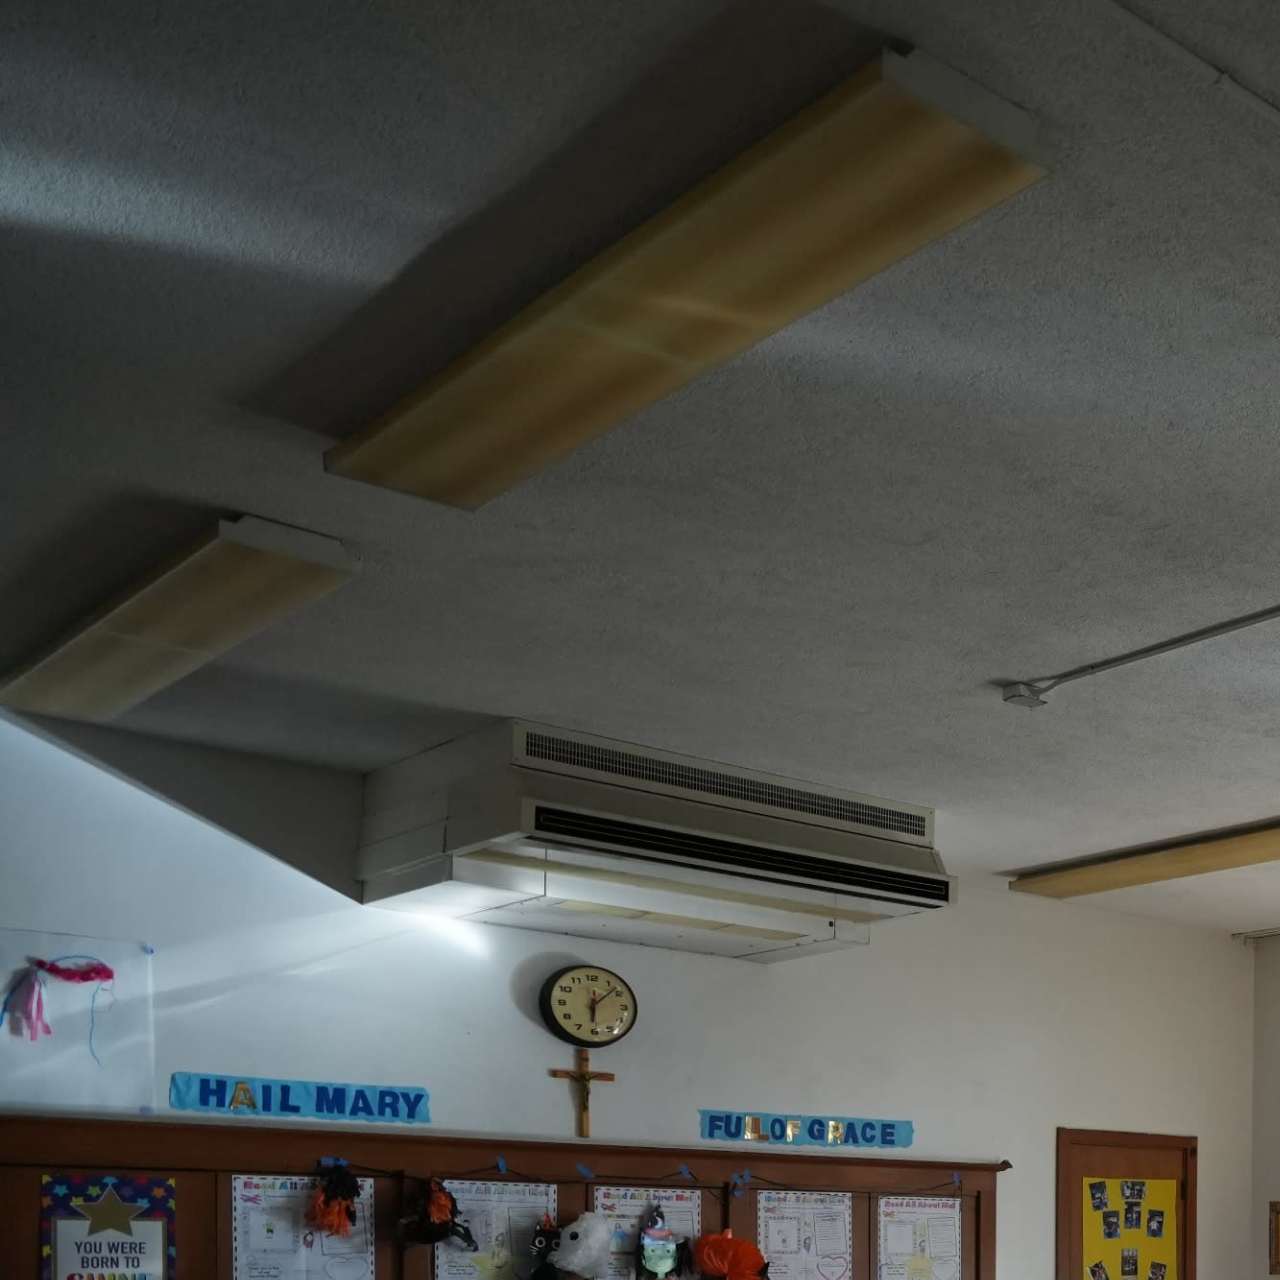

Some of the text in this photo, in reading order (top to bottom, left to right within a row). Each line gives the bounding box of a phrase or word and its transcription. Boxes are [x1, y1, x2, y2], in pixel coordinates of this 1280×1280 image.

[585, 974, 599, 982] 12
[559, 985, 572, 993] 10
[199, 1078, 425, 1119] HAIL MARY
[770, 1118, 801, 1143] OF
[807, 1118, 896, 1145] GRACE
[74, 1241, 146, 1254] YOU WERE
[81, 1256, 140, 1269] BORN TO
